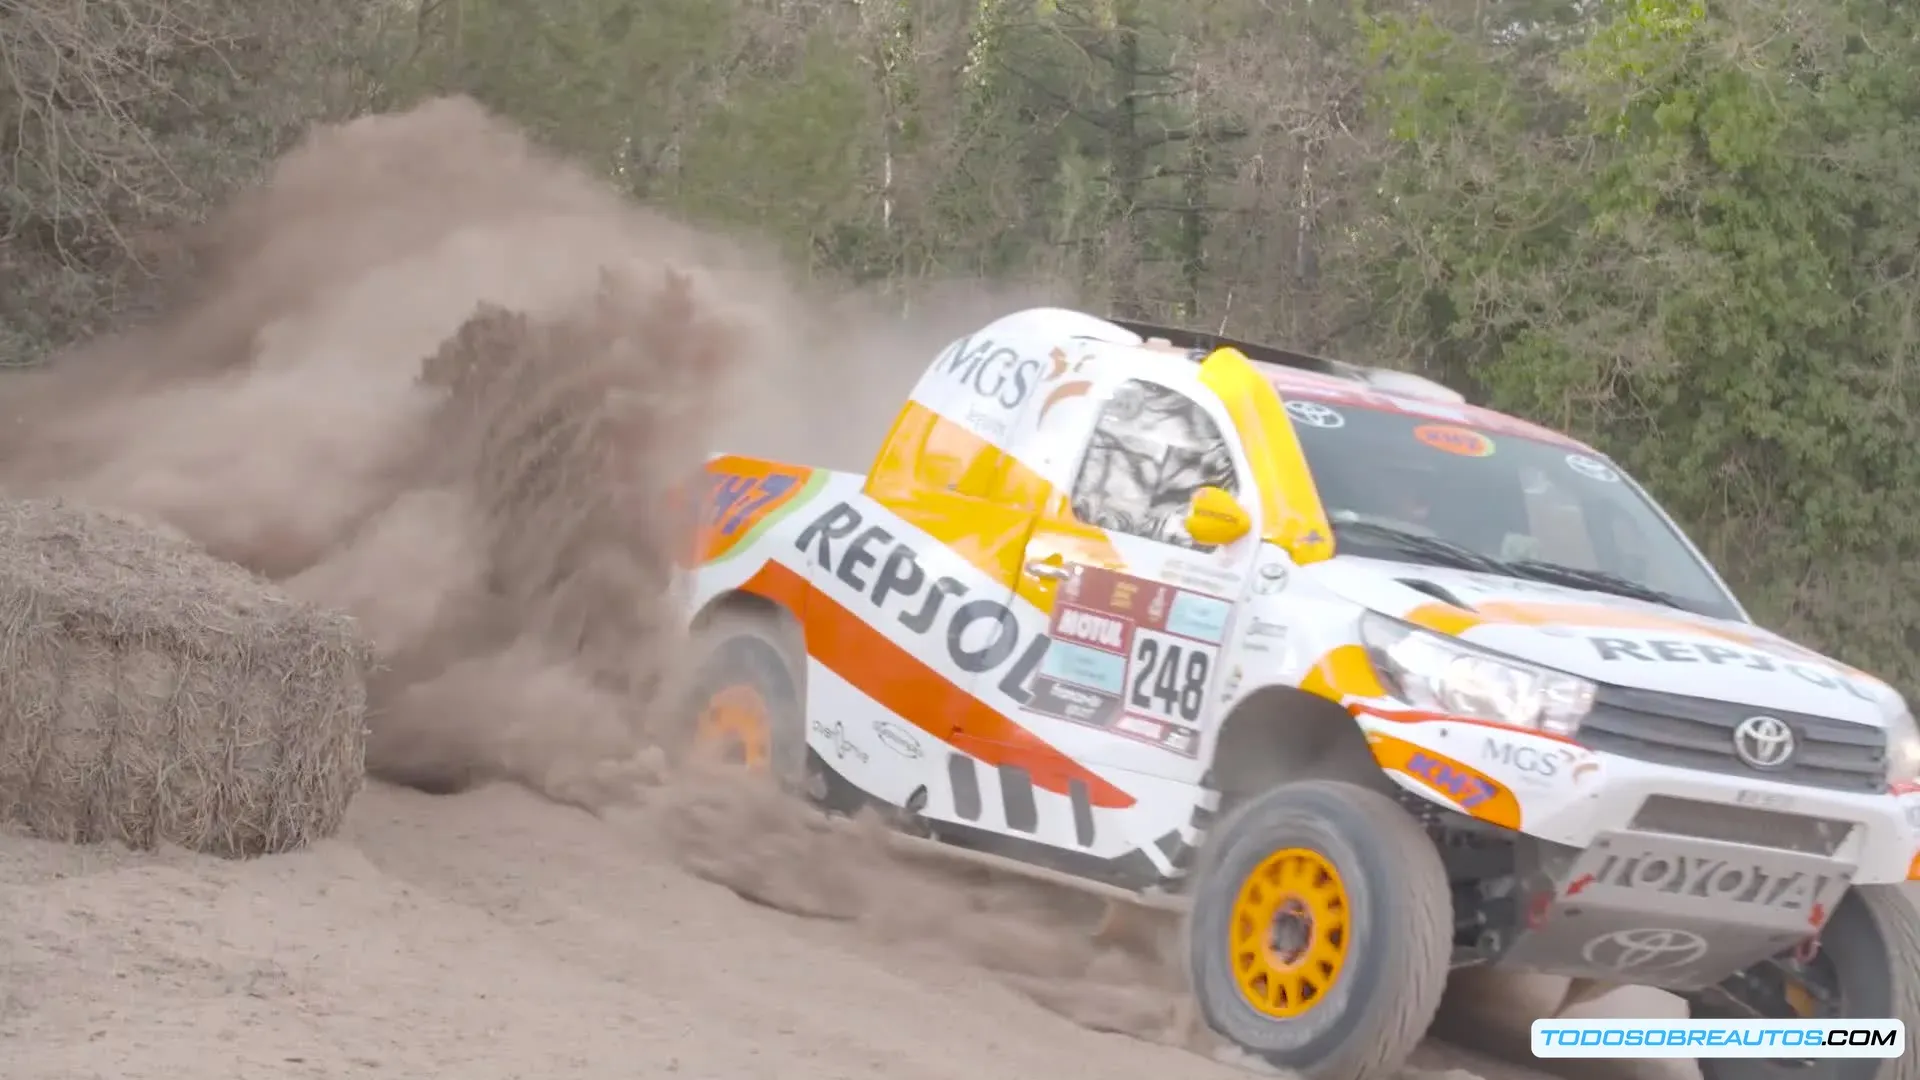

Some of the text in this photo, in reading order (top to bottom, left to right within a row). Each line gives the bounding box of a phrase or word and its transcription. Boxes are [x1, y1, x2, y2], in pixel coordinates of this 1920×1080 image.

[935, 339, 1040, 409] MGS
[794, 501, 1052, 704] REPSOL
[1131, 638, 1208, 722] 248
[1586, 636, 1880, 703] REPSOL
[1483, 737, 1557, 777] MGS
[1596, 850, 1833, 910] TOYOTA
